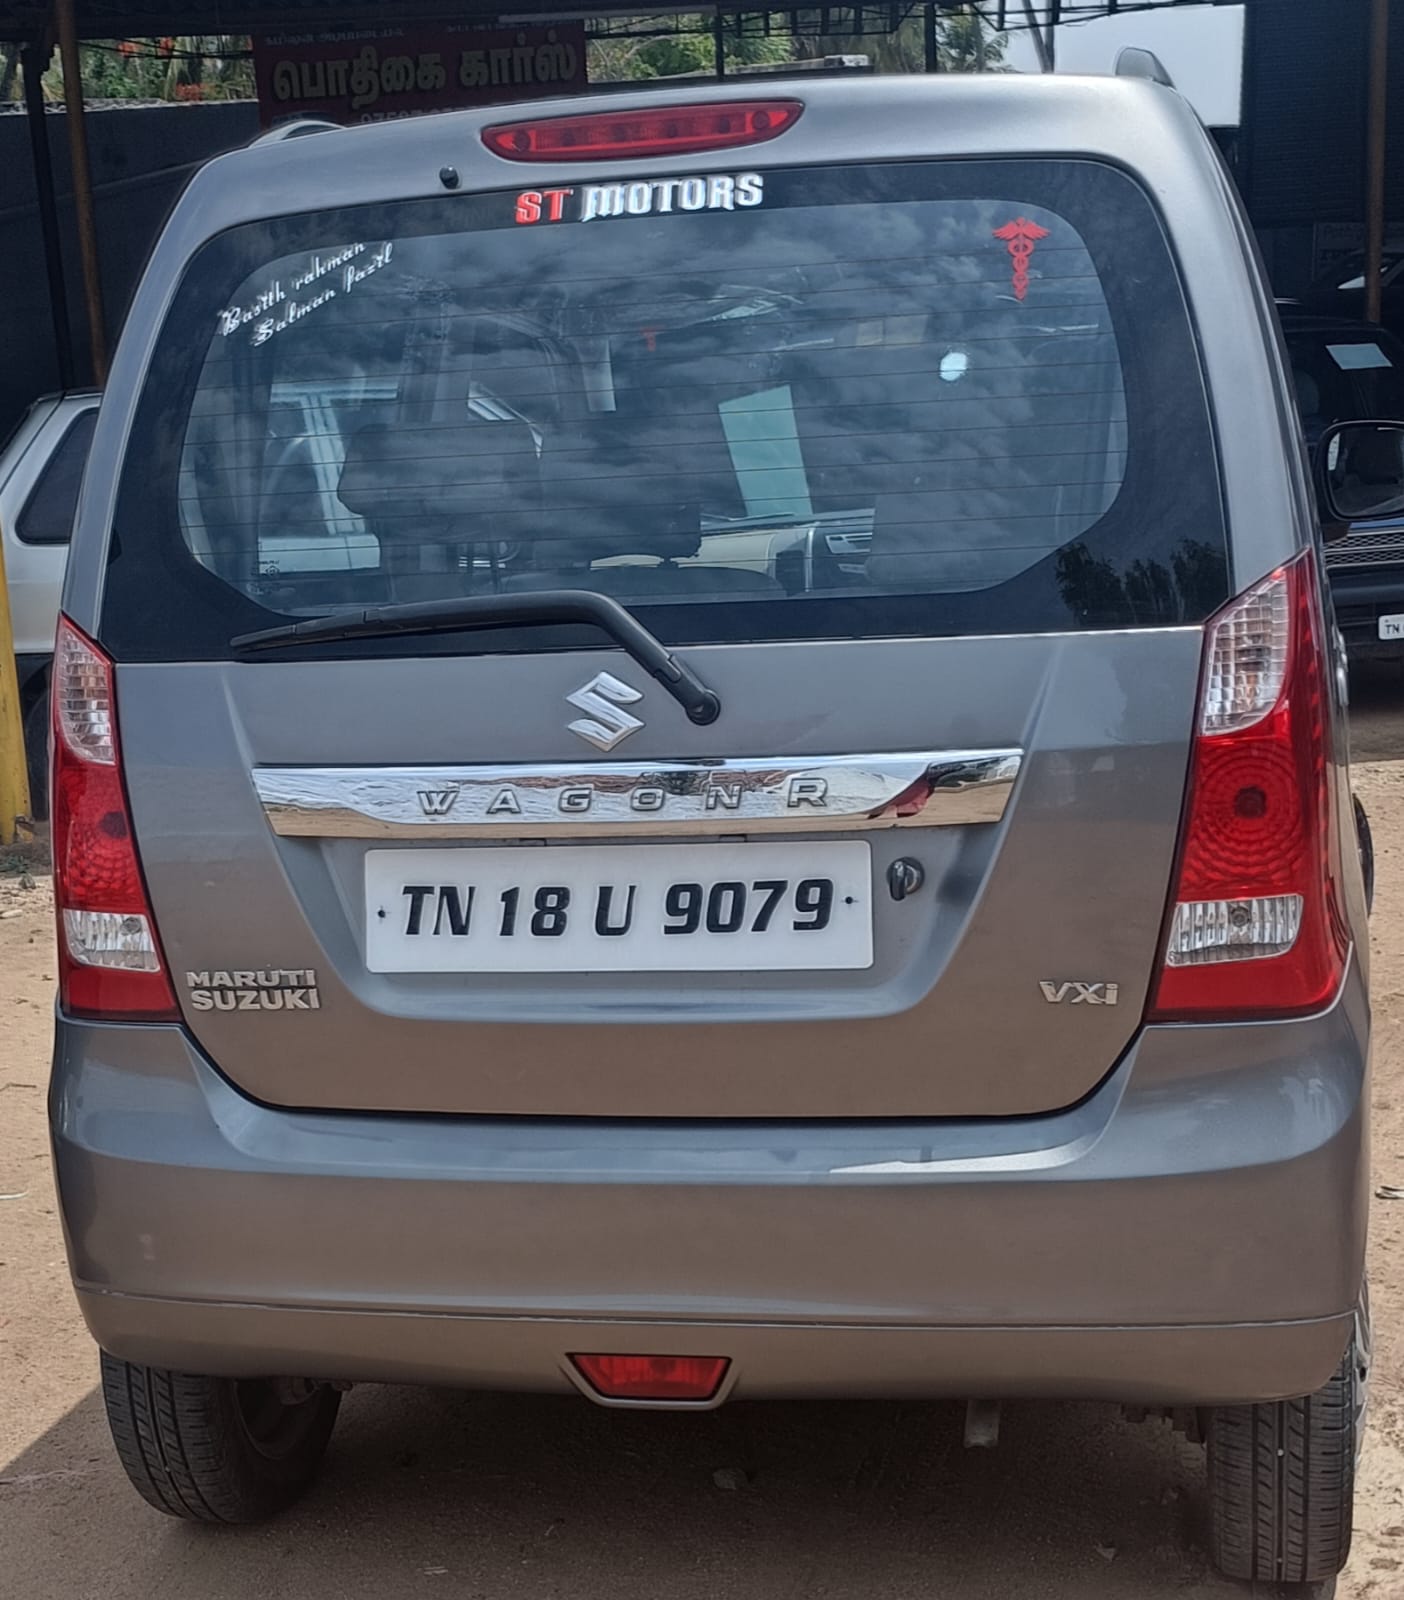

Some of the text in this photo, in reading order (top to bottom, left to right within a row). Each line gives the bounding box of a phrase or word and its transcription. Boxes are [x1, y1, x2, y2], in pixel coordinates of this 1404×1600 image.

[459, 29, 577, 86] கார்ஸ்
[515, 173, 764, 223] ST MOTORS
[291, 242, 366, 290] rahman
[250, 288, 337, 347] Salman
[1384, 623, 1400, 634] TN
[402, 878, 834, 937] TN 18 U 9079
[186, 969, 316, 987] MARUTI
[191, 988, 320, 1010] SUZUKI
